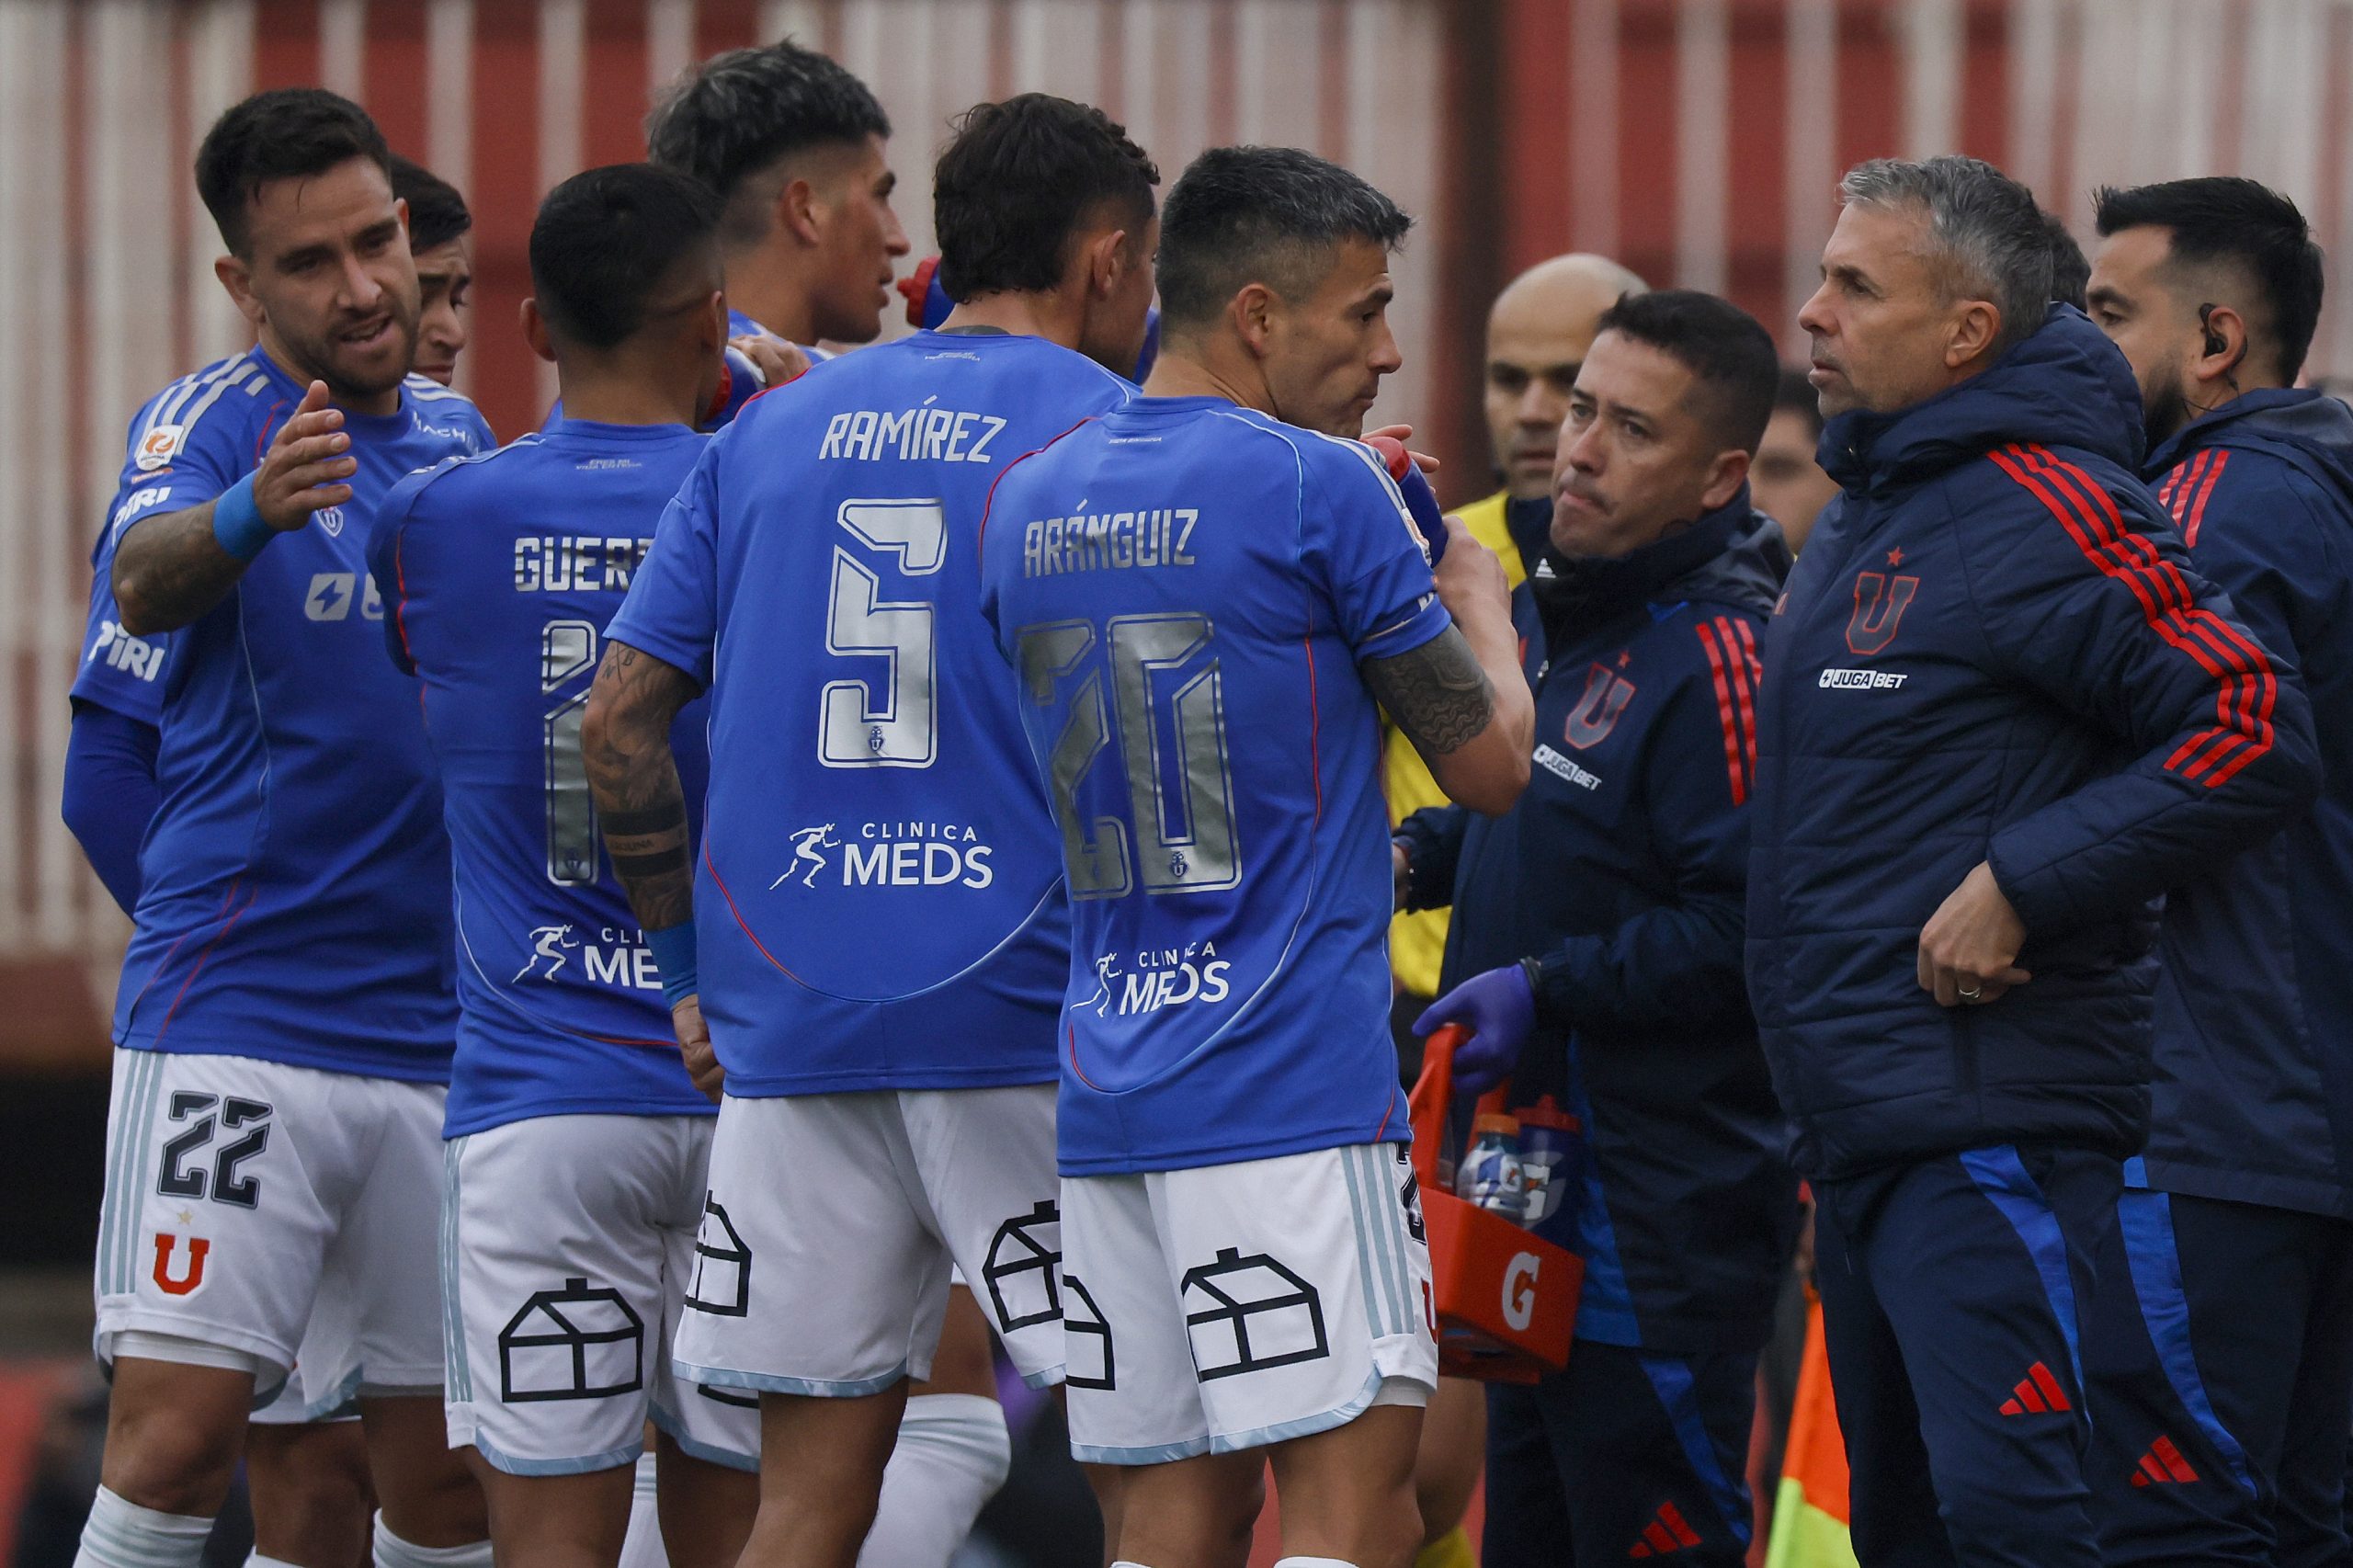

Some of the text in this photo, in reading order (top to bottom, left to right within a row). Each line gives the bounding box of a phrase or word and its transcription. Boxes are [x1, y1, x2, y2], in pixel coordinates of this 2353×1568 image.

[819, 394, 1007, 463] RAMÍREZ
[1024, 498, 1199, 578] ARÁNGUIZ
[817, 498, 949, 768] 5
[1846, 572, 1920, 655] U
[1564, 662, 1637, 749] U
[1014, 611, 1242, 901] 20
[843, 843, 994, 889] MEDS
[862, 822, 977, 842] CLINICA
[584, 945, 663, 990] ME
[601, 927, 642, 944] CLI
[157, 1090, 273, 1210] 22
[153, 1233, 210, 1295] U
[1502, 1252, 1541, 1331] G
